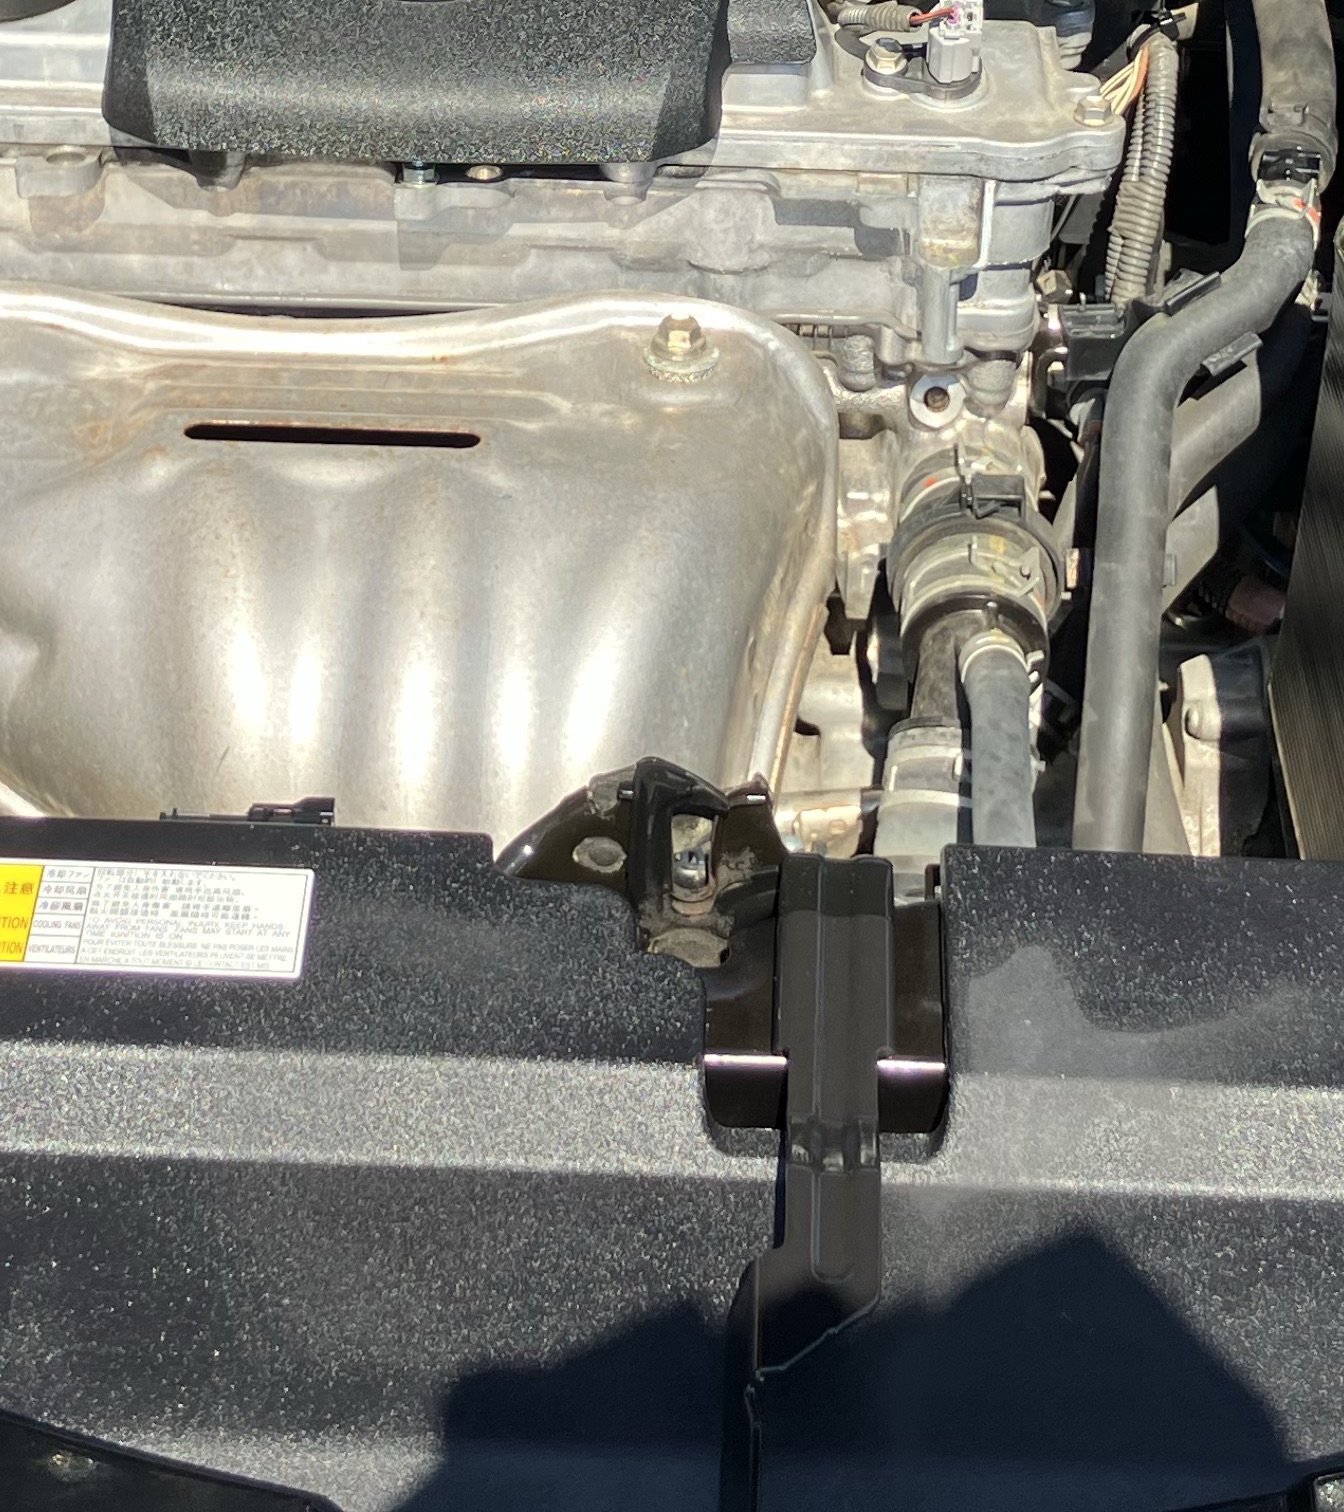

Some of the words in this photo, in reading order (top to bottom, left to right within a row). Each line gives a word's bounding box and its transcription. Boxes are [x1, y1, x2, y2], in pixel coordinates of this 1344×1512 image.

[4, 881, 34, 895] 注意
[33, 919, 62, 929] COOLING
[64, 920, 81, 930] FANS
[29, 943, 75, 955] VENTILATEURS
